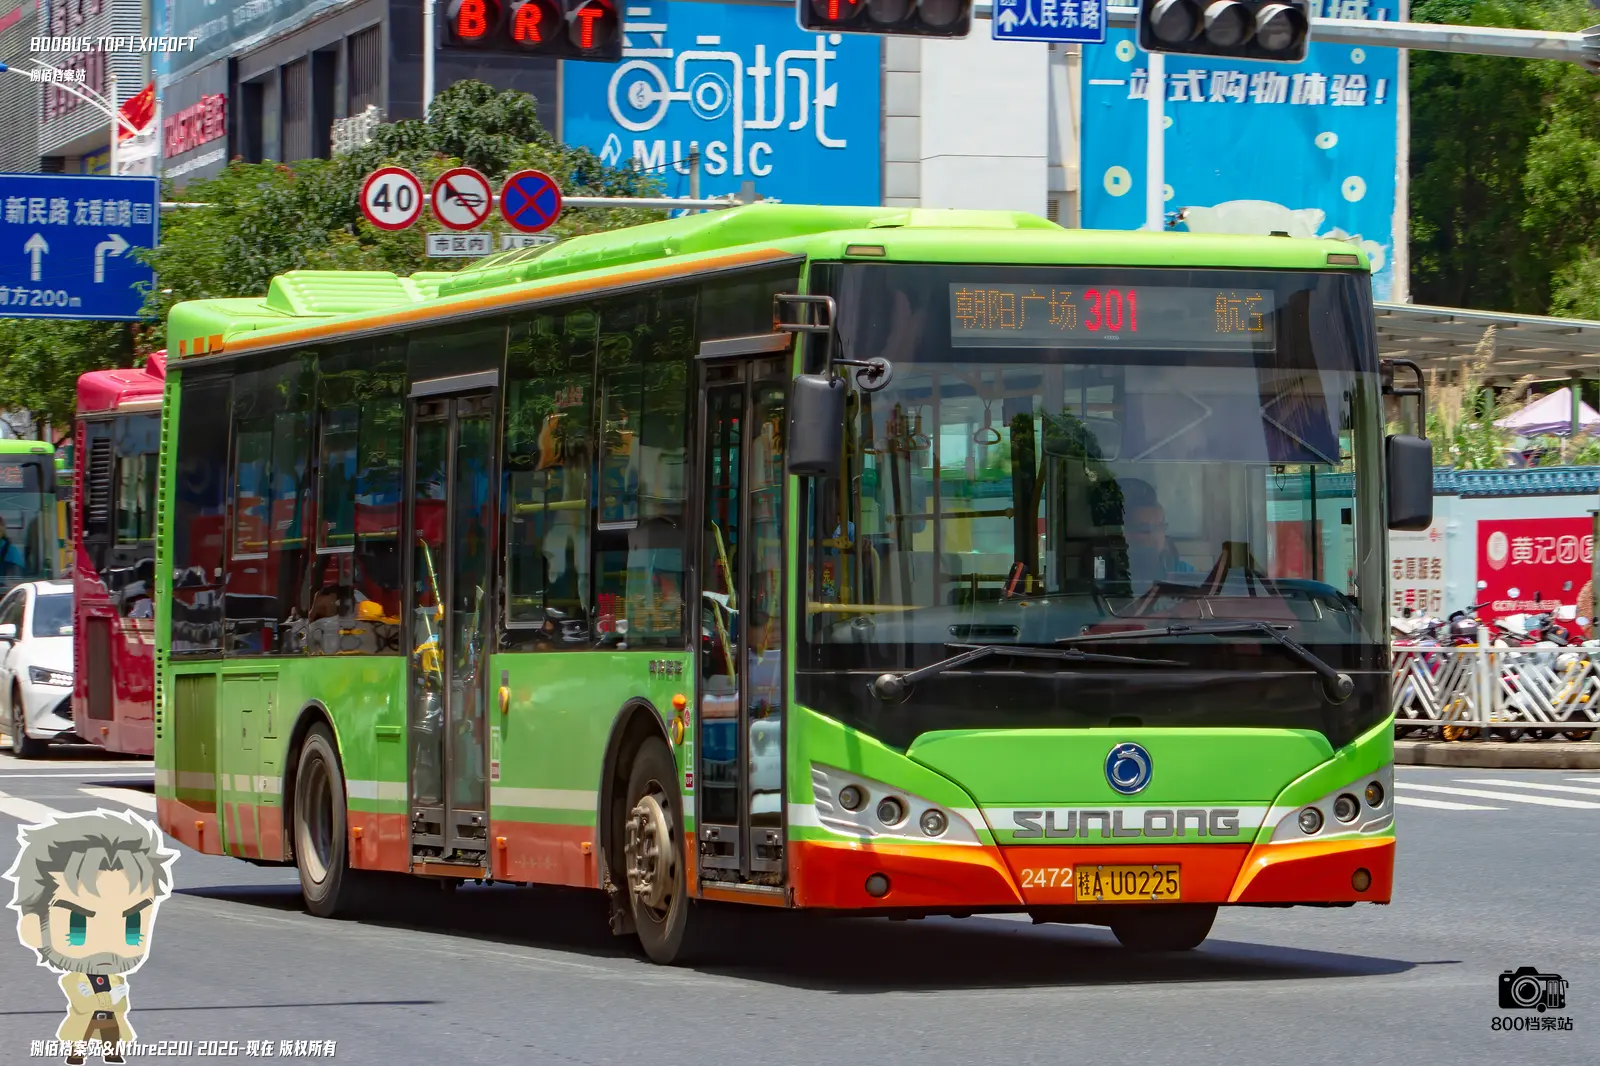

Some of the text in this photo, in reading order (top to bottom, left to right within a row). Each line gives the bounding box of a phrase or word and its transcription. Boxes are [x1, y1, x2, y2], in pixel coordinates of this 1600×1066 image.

[457, 0, 604, 48] BRT
[1019, 0, 1100, 29] 人民东路
[632, 140, 774, 177] MUSIC
[5, 195, 70, 226] 新民路
[73, 197, 133, 228] 友爱南路
[372, 183, 413, 213] 40
[954, 287, 1078, 331] 朝阳广场
[1082, 288, 1138, 333] 301
[1012, 808, 1241, 839] SUNLONG
[1020, 867, 1074, 889] 2472
